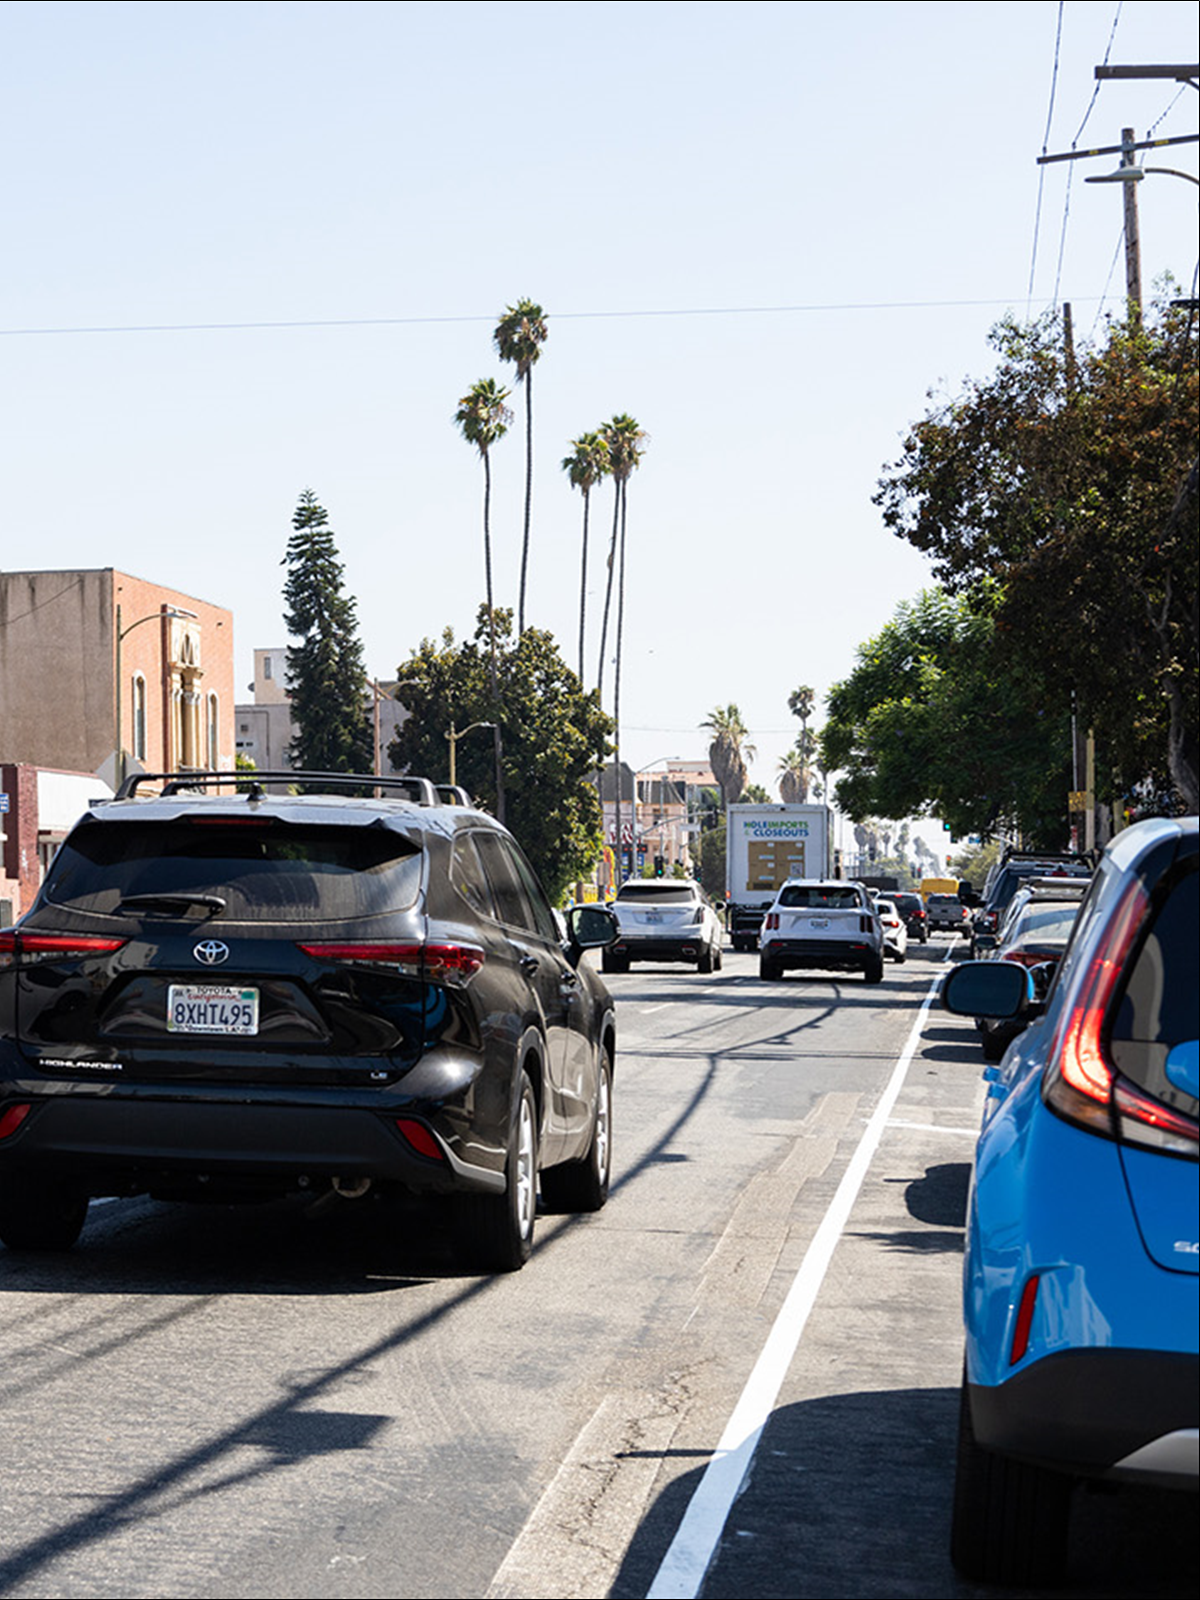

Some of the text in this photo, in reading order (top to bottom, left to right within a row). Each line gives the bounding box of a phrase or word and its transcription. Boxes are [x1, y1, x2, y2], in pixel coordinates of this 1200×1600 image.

[753, 829, 809, 837] CLOSEOUTS
[197, 985, 232, 995] TOYOTA
[175, 1002, 252, 1026] 8XHT495
[39, 1059, 123, 1070] HIGHLANDER
